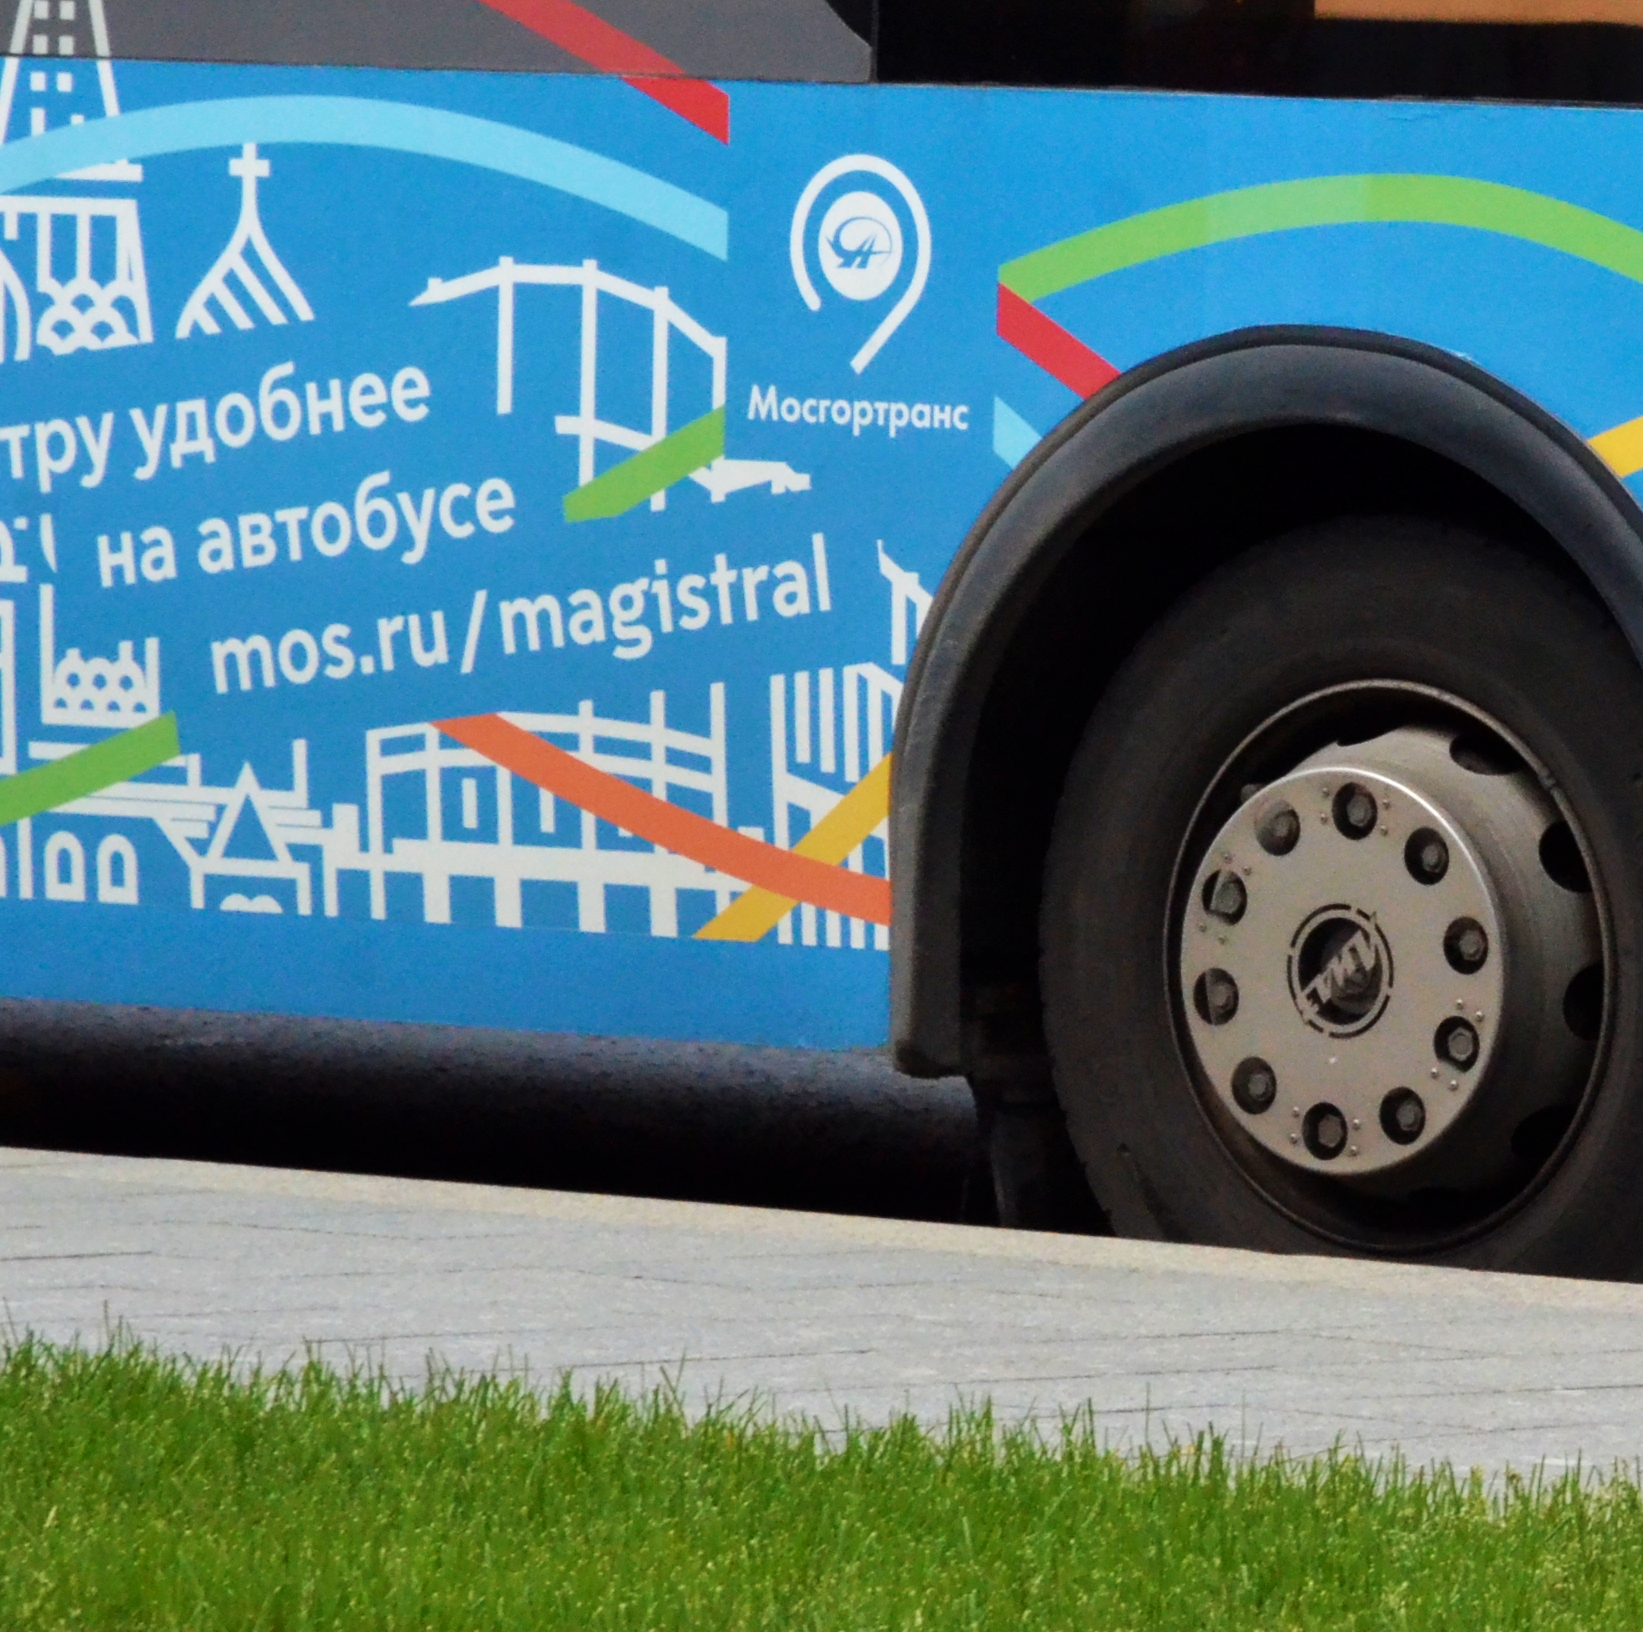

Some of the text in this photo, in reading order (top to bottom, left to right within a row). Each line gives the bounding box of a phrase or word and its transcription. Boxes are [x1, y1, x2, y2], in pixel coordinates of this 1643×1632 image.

[130, 360, 432, 481] удобнее
[747, 383, 971, 439] Мосгортранс
[97, 470, 516, 588] на автобусе
[210, 532, 832, 694] mos.ru/magistral
